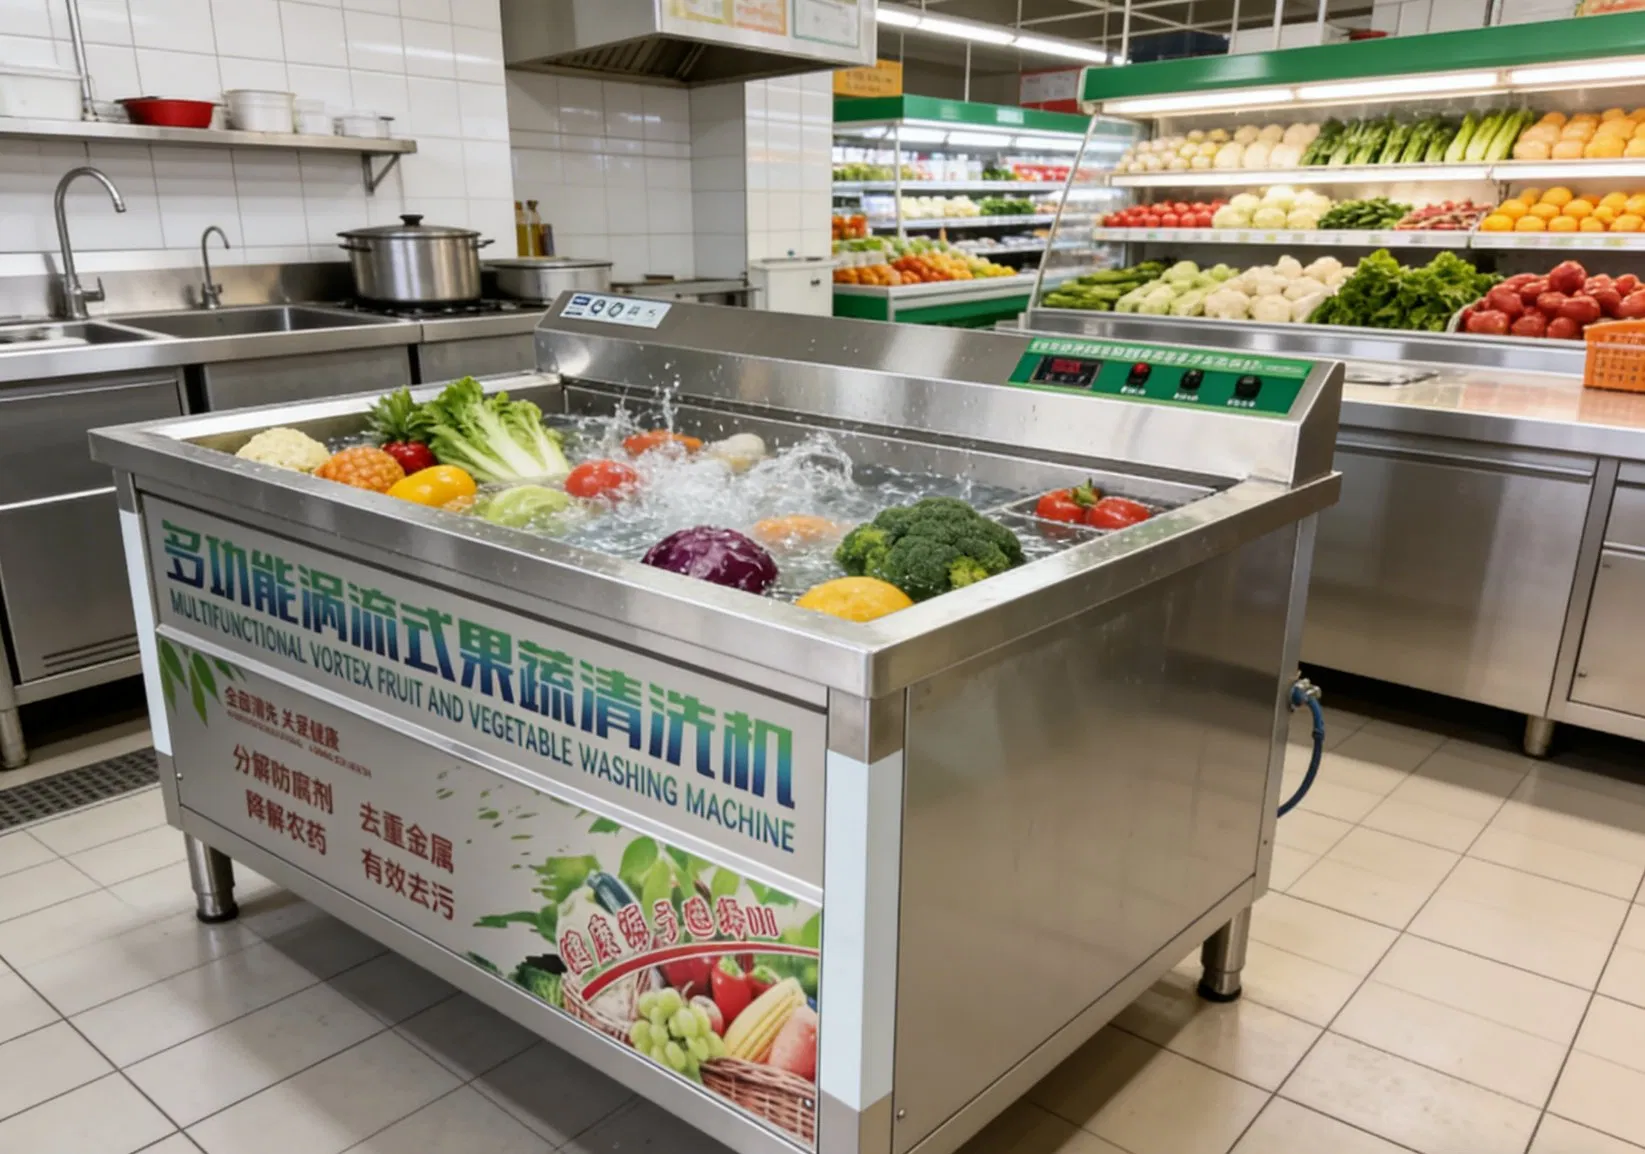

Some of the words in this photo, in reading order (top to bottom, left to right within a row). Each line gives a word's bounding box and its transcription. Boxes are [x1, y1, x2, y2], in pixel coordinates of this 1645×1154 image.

[162, 518, 795, 809] 多功能涡流式果蔬清洗机
[170, 588, 307, 664] MULTIFUNCTIONAL
[309, 640, 373, 689] VORTEX
[378, 667, 423, 708] FRUIT
[428, 686, 464, 723] AND
[468, 701, 572, 766] VEGETABLE
[578, 741, 677, 807] WASHING
[686, 783, 795, 853] MACHINE
[233, 744, 333, 815] 分解防腐剂
[246, 789, 326, 855] 降解农药
[359, 801, 454, 874] 去重金属
[361, 848, 455, 921] 有效去污
